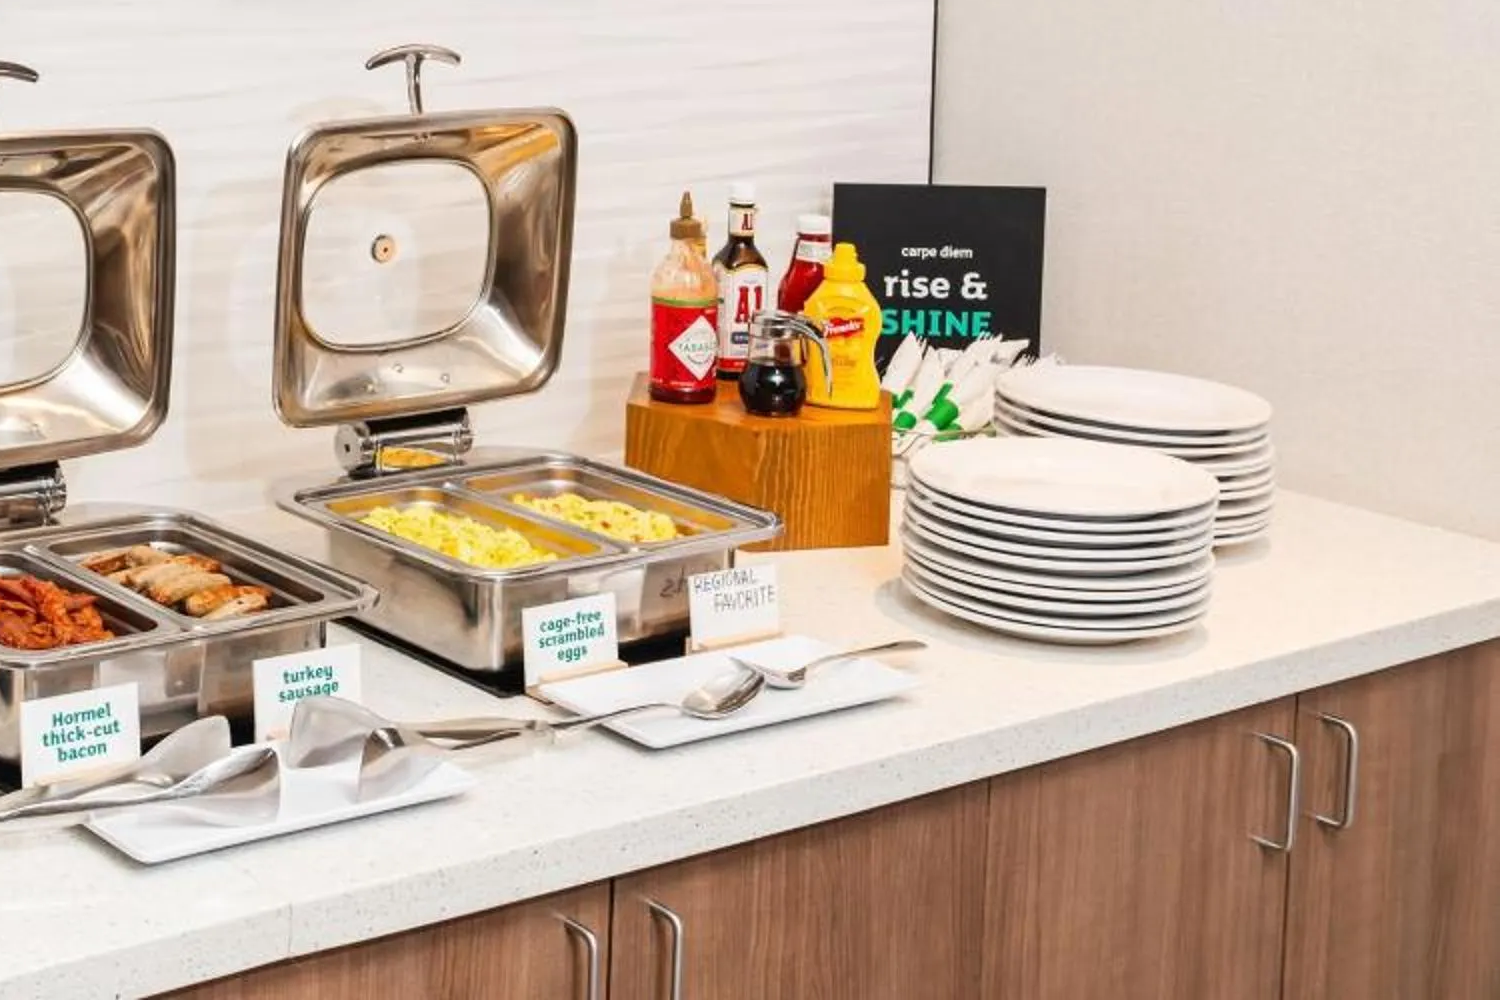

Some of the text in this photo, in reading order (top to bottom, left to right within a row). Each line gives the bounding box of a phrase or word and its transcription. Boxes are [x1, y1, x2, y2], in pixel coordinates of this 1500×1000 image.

[901, 245, 974, 260] carpe diem
[883, 269, 988, 300] rise &
[881, 309, 991, 336] SHINE
[694, 567, 758, 593] REGIONAL
[714, 584, 776, 613] FAVORITE
[539, 610, 602, 633] cage-free
[538, 624, 605, 649] scrambled
[557, 644, 588, 663] eggs
[283, 665, 333, 685] turkey
[278, 680, 339, 702] sausage
[52, 702, 111, 728] Hormel
[42, 720, 121, 748] thick-cut
[57, 742, 107, 763] bacon
